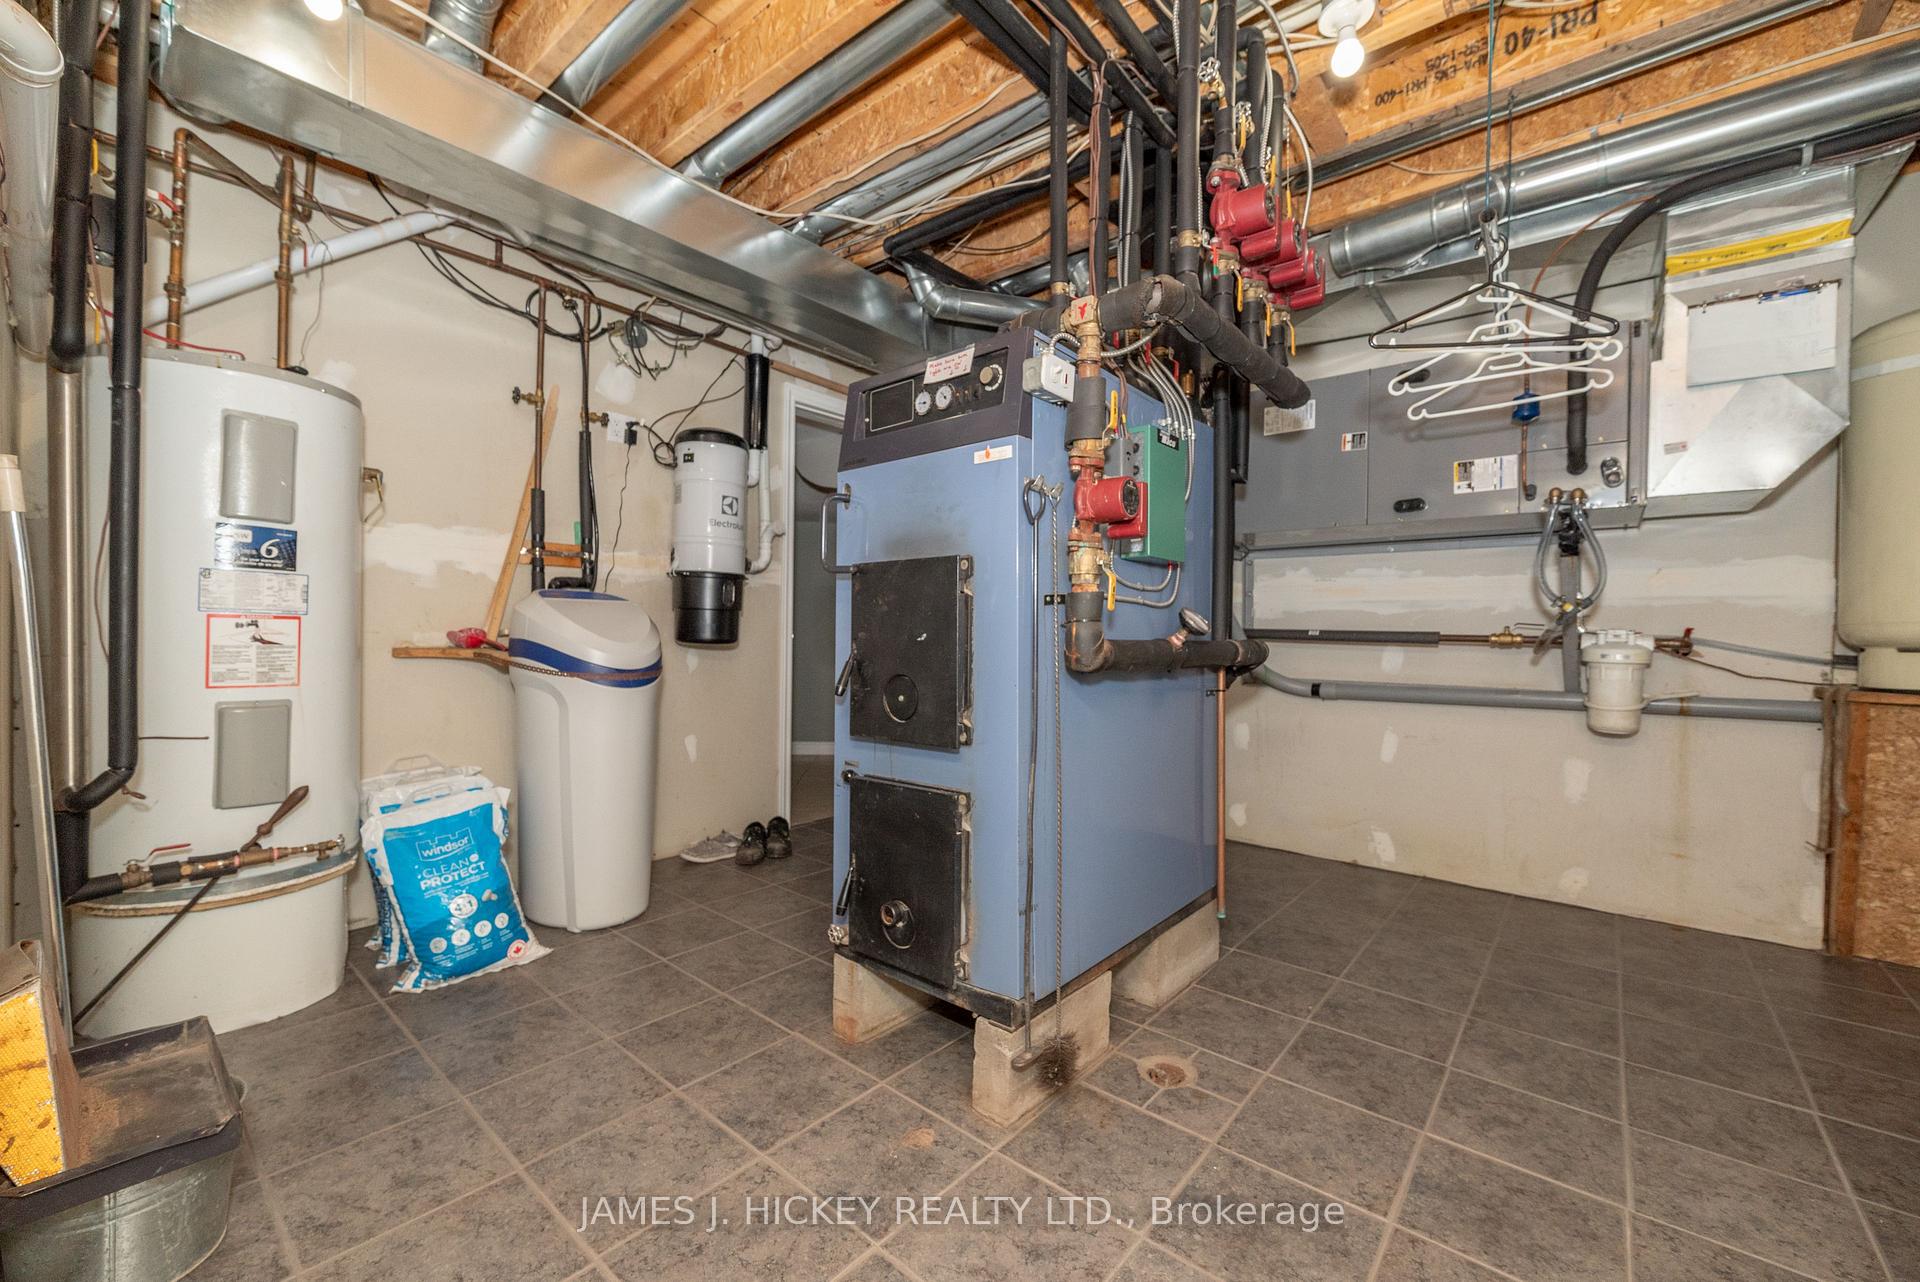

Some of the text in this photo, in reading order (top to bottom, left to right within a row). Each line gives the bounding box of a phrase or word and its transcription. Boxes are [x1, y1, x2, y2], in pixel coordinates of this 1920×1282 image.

[1504, 0, 1598, 55] PRI-40
[260, 538, 281, 560] 6
[421, 836, 469, 858] windsor
[420, 861, 486, 891] PROTECT
[422, 857, 470, 879] CLEAN
